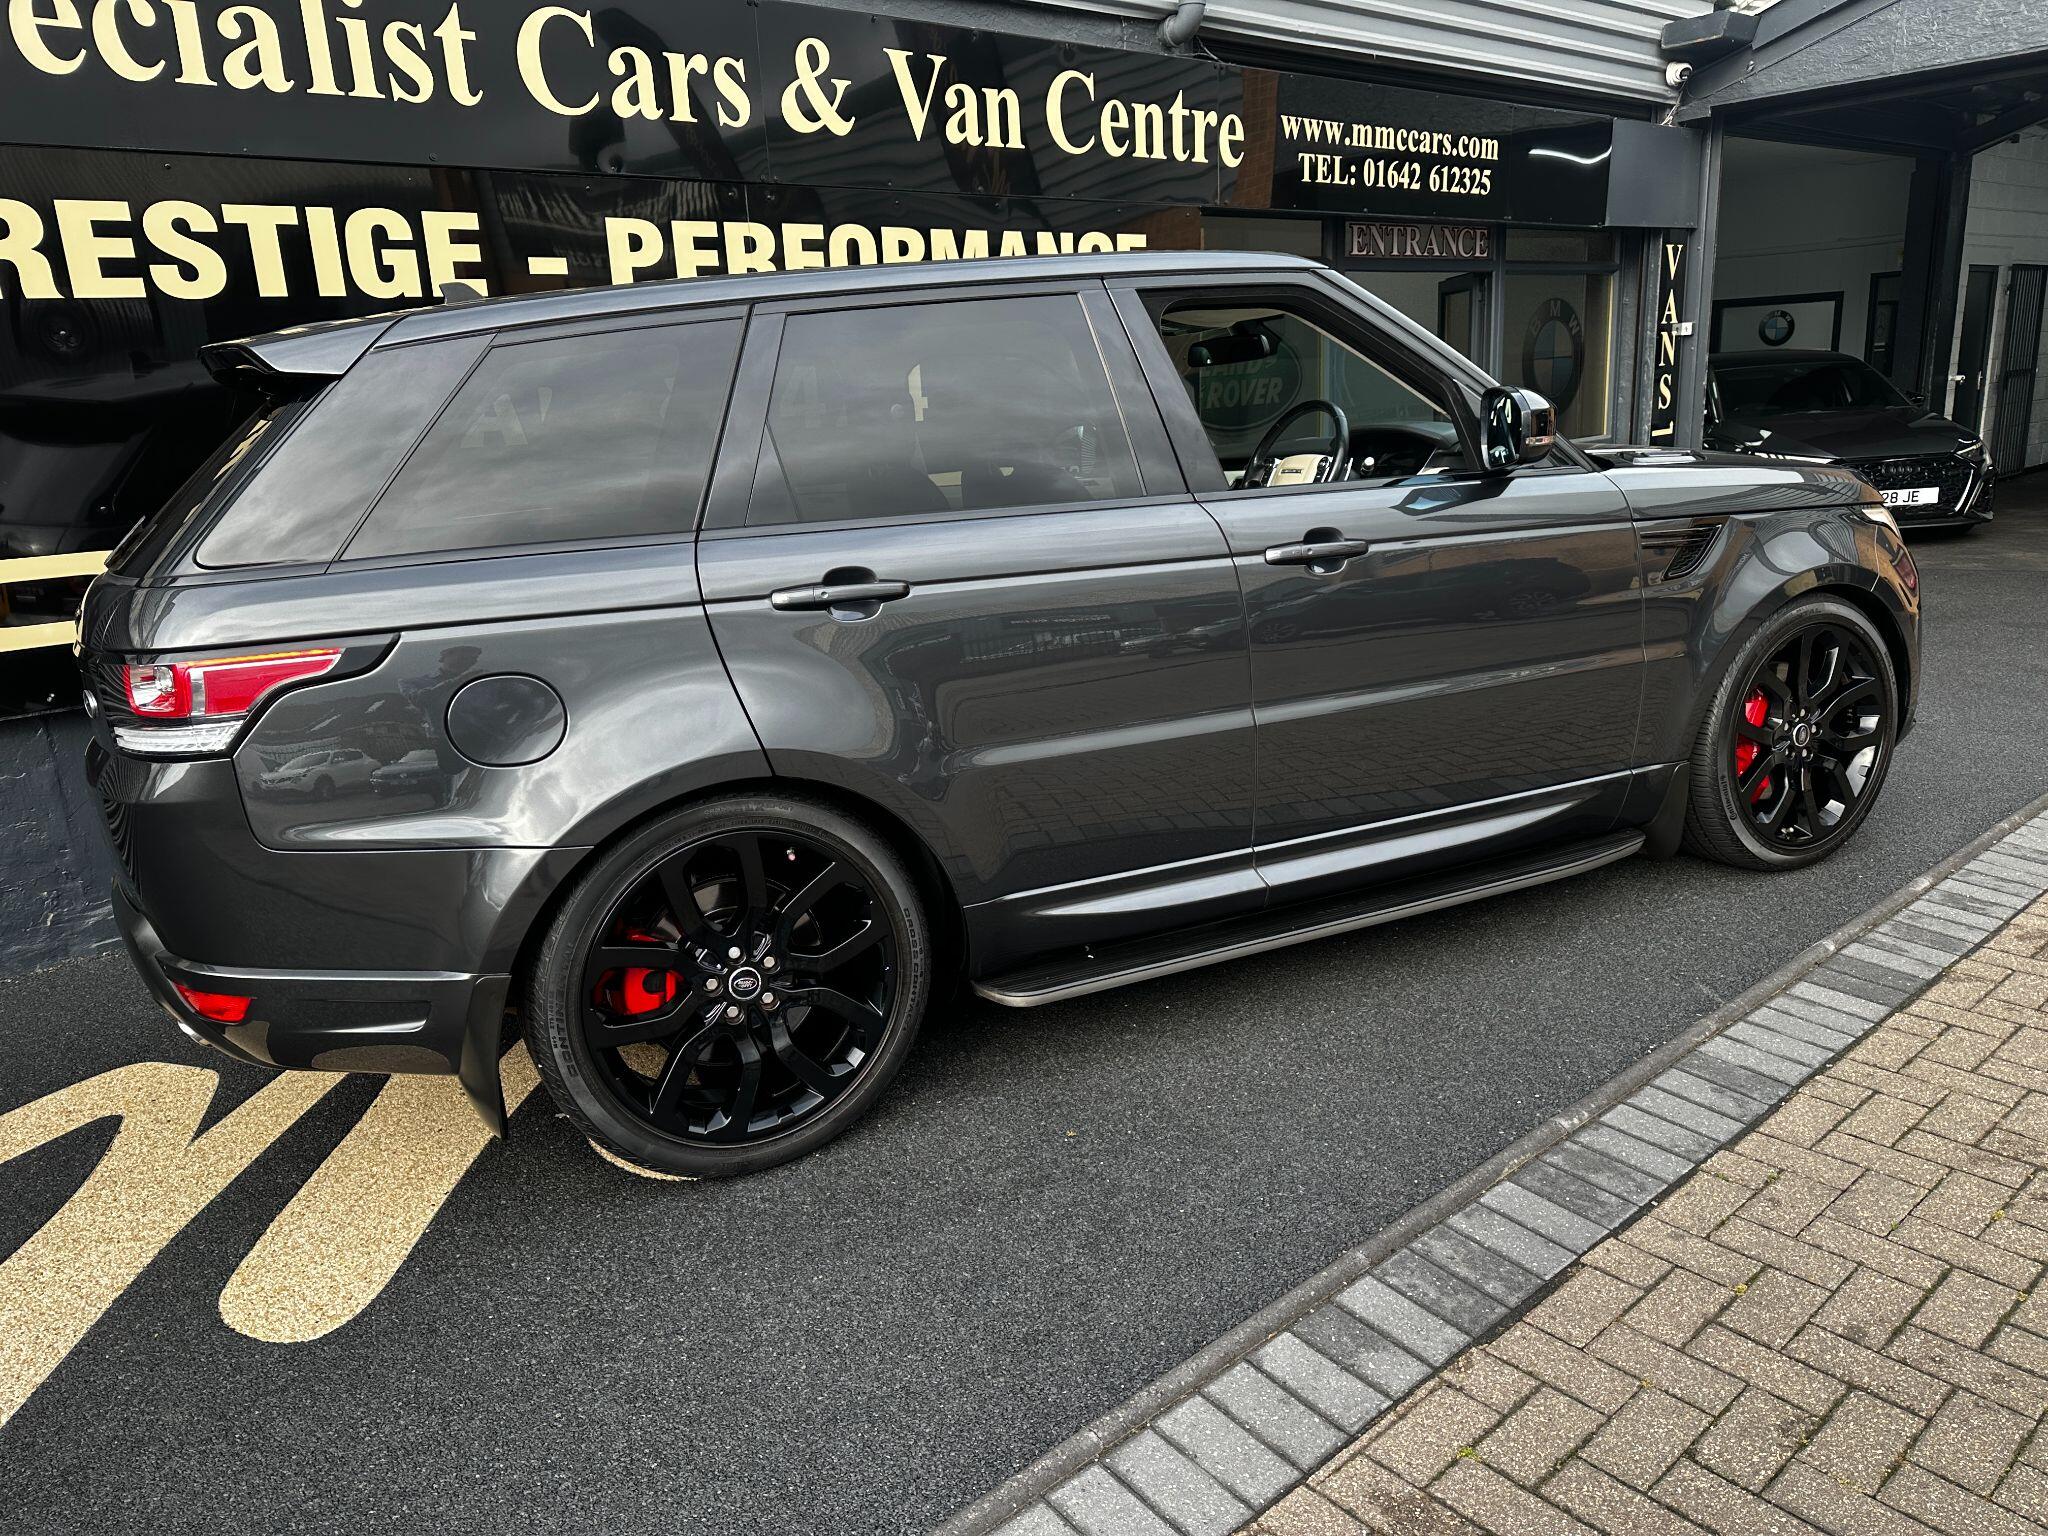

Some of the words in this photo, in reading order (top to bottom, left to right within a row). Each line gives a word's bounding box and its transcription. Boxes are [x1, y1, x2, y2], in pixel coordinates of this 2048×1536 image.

[516, 6, 751, 128] Cars
[780, 37, 855, 137] &
[885, 48, 1025, 149] Van
[1045, 70, 1245, 168] Centre
[1281, 114, 1499, 161] www.mmccars.com
[1298, 152, 1356, 186] TEL:
[1363, 160, 1421, 190] 01642
[1429, 167, 1492, 197] 612325
[605, 216, 1147, 286] PERFOR
[1349, 223, 1488, 258] ENTRANCE
[1657, 244, 1684, 409] VANS
[1206, 377, 1283, 408] ROVER
[1882, 492, 1898, 504] 28
[1902, 490, 1920, 503] JE
